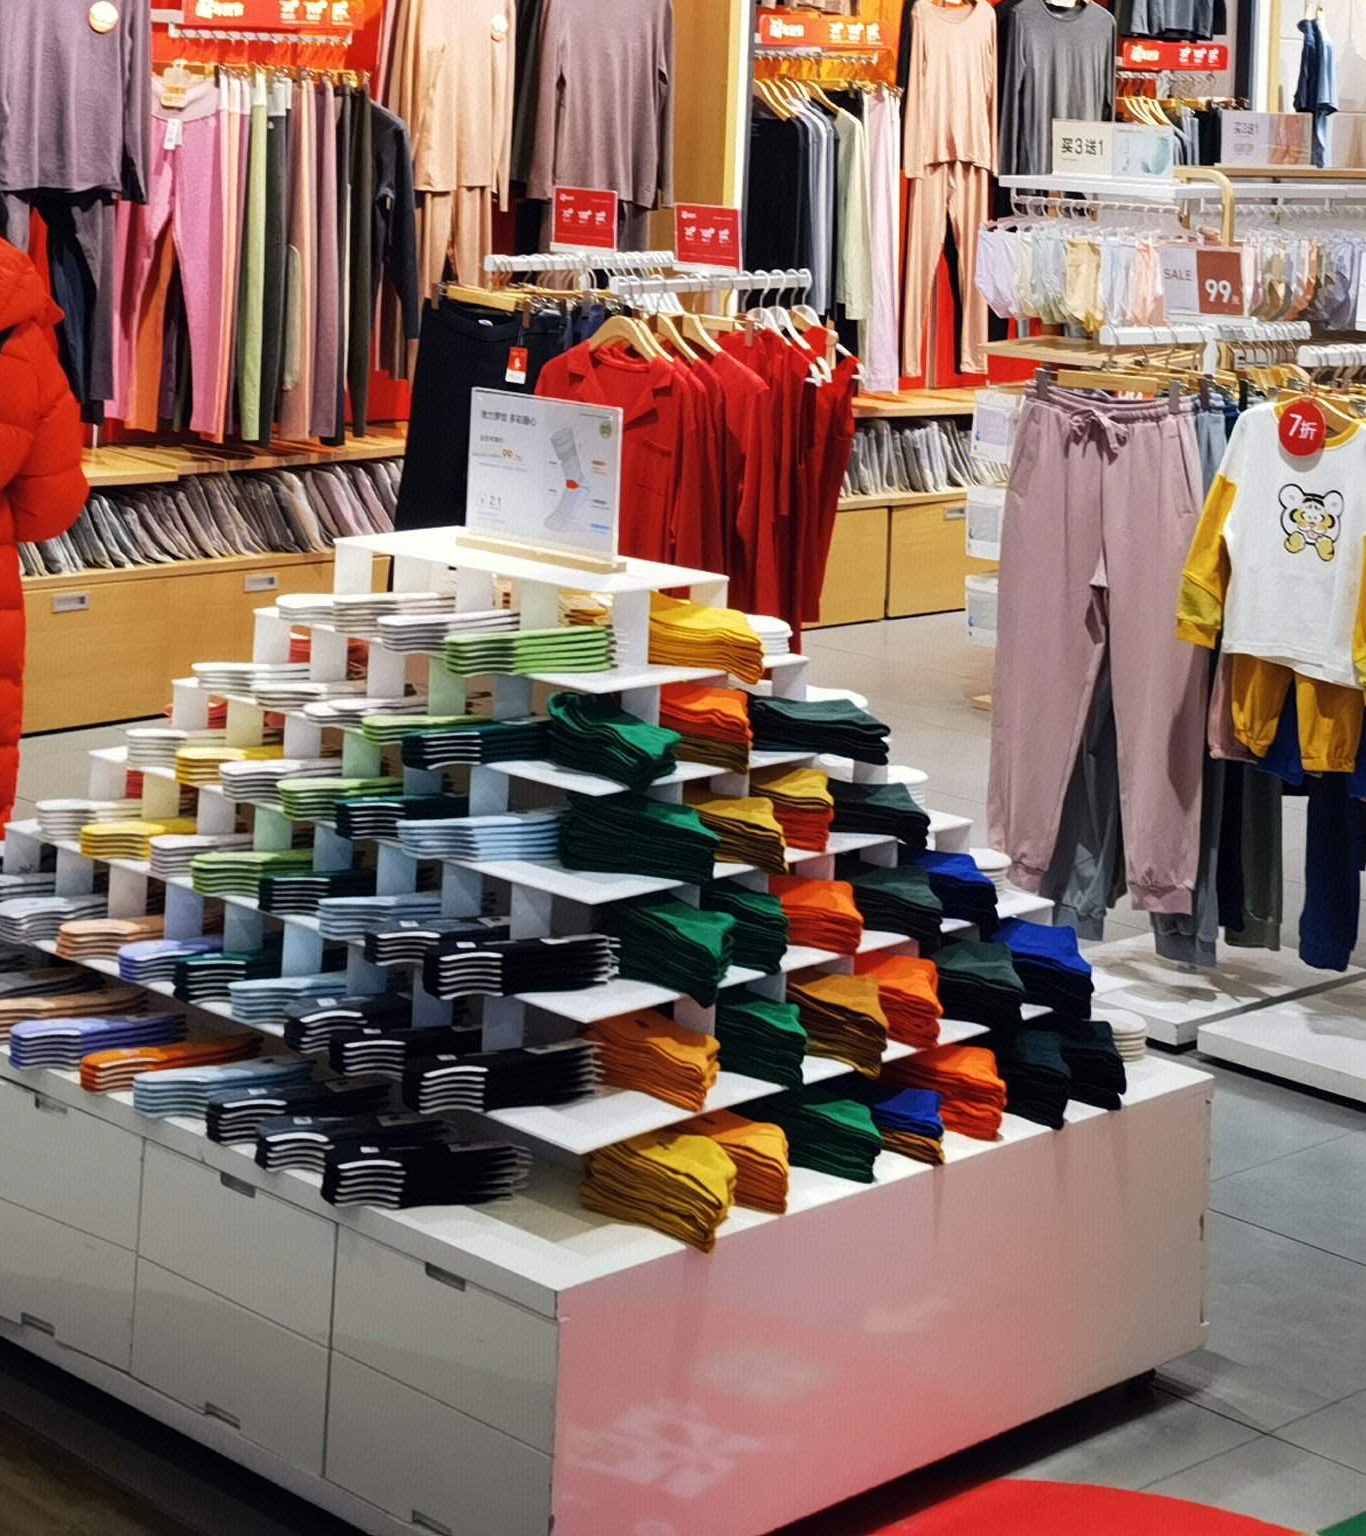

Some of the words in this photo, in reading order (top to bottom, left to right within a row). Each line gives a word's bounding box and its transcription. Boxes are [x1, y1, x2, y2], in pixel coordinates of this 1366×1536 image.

[1061, 137, 1104, 156] 买3送1
[1162, 268, 1192, 282] SALE
[1288, 413, 1318, 440] 7折
